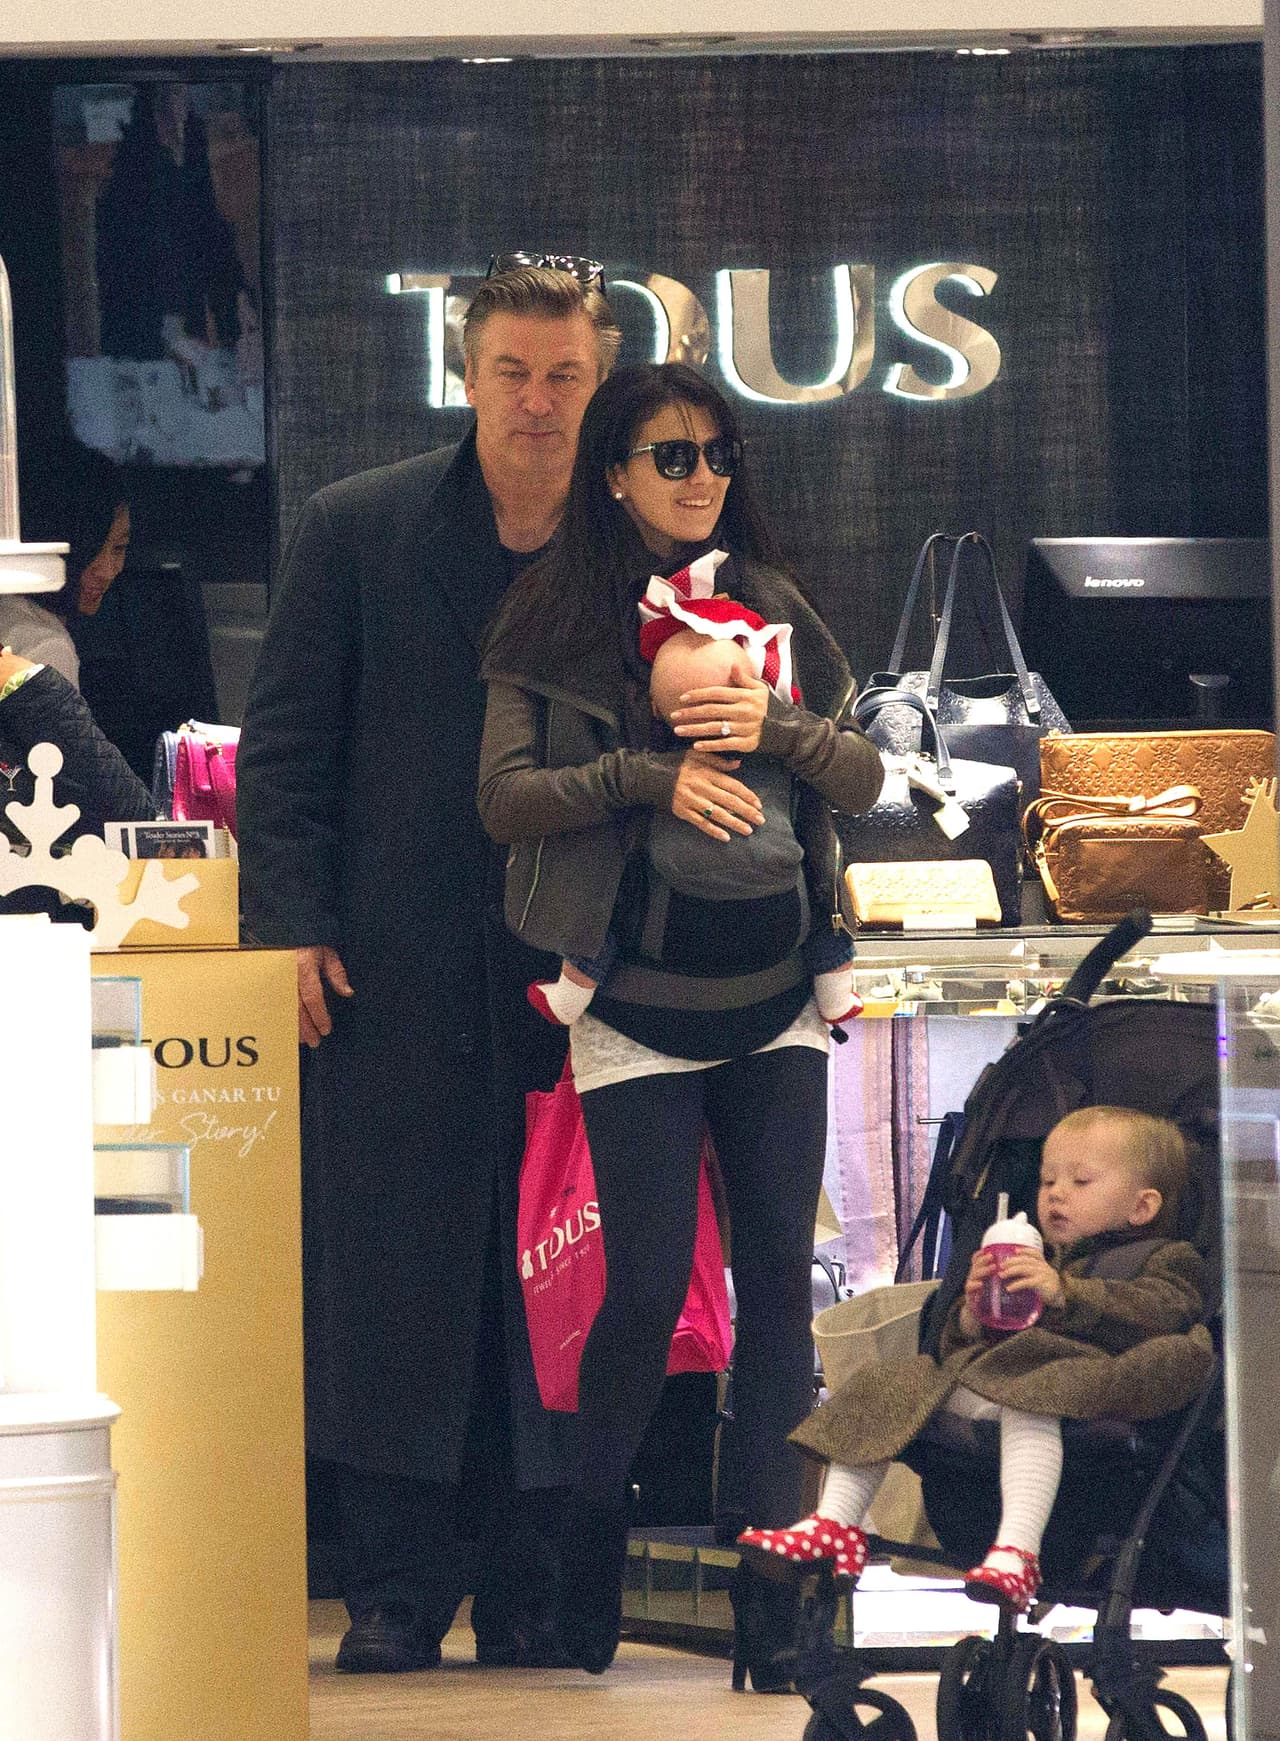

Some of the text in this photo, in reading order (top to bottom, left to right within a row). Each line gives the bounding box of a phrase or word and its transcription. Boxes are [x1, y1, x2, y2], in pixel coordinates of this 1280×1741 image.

[1084, 575, 1145, 588] lenovo
[140, 1036, 259, 1069] OUS
[172, 1087, 247, 1104] GANAR
[252, 1086, 282, 1102] TU
[535, 1201, 601, 1271] TOUS
